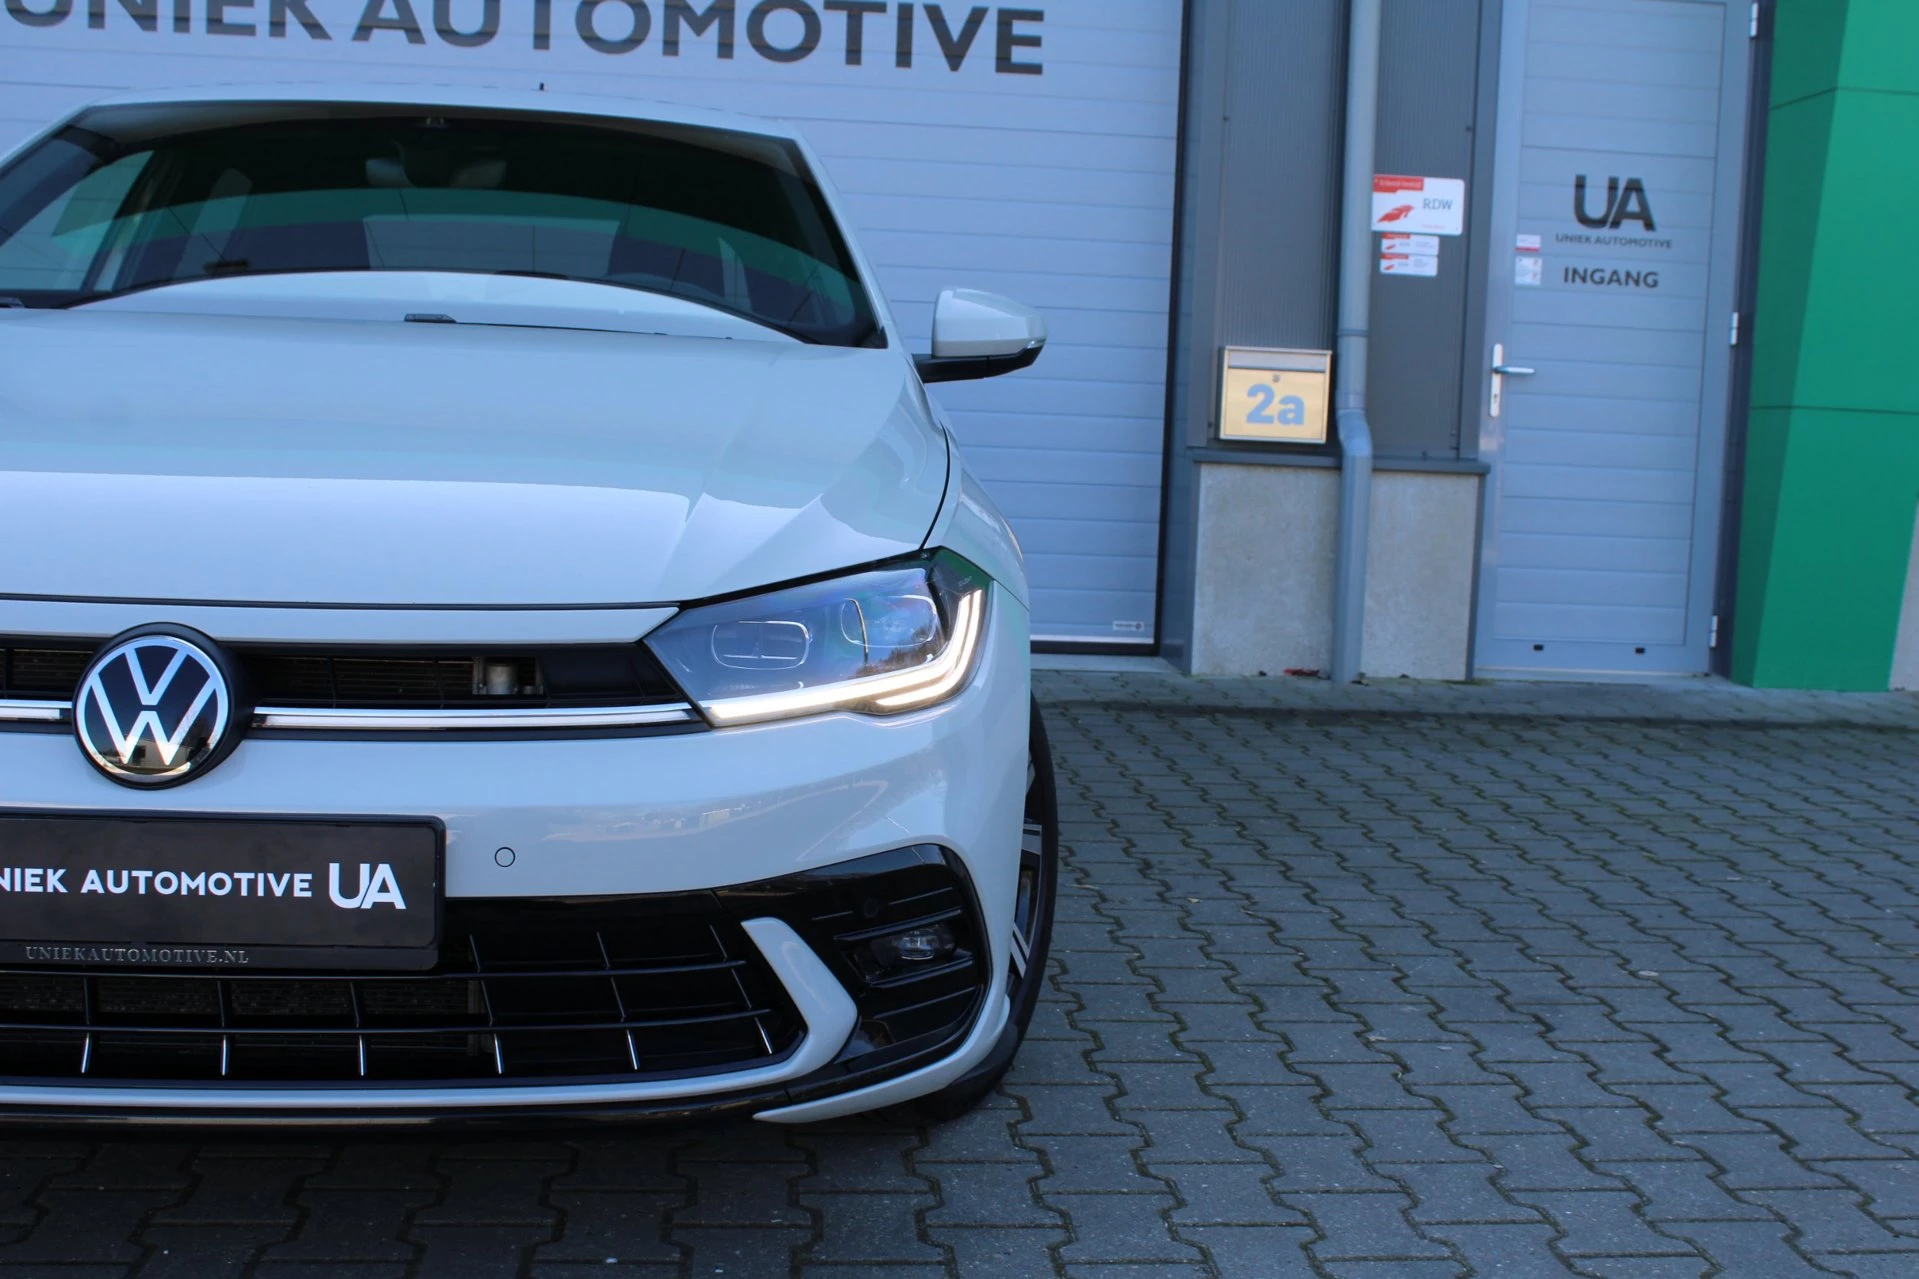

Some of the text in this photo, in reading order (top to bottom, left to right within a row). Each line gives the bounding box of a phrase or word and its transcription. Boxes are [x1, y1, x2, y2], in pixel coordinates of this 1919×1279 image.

[352, 0, 1044, 75] AUTOMOTIVE
[1423, 198, 1453, 210] RDW
[1573, 174, 1656, 232] UA
[1556, 233, 1673, 249] UNIEK AUTOMOTIVE
[1564, 267, 1659, 288] INGANG
[1246, 384, 1305, 426] 2a
[80, 869, 312, 898] AUTOMOTIVE
[329, 862, 406, 910] UA
[25, 946, 249, 964] UNIEKAUTOMOTIVE.NL
